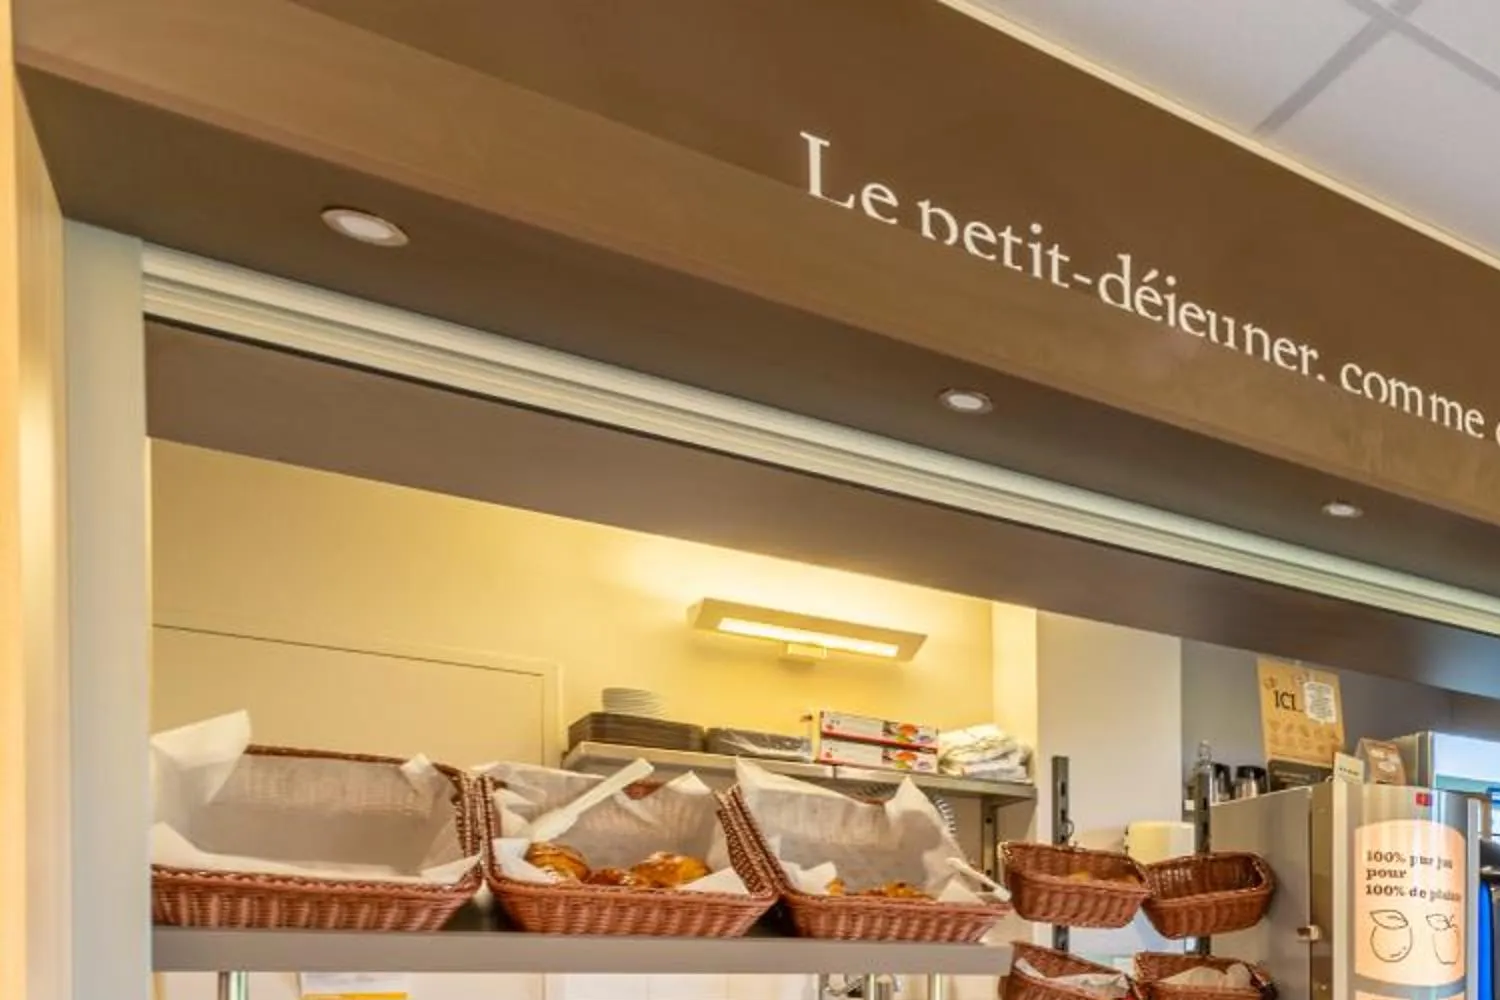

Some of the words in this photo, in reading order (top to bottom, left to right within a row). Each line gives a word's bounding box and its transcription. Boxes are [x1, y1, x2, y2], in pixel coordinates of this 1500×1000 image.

[800, 131, 898, 225] Le
[1340, 363, 1485, 438] comme
[1366, 850, 1406, 863] 100%
[1366, 868, 1407, 881] pour
[1366, 884, 1405, 897] 100%
[1409, 888, 1426, 898] de
